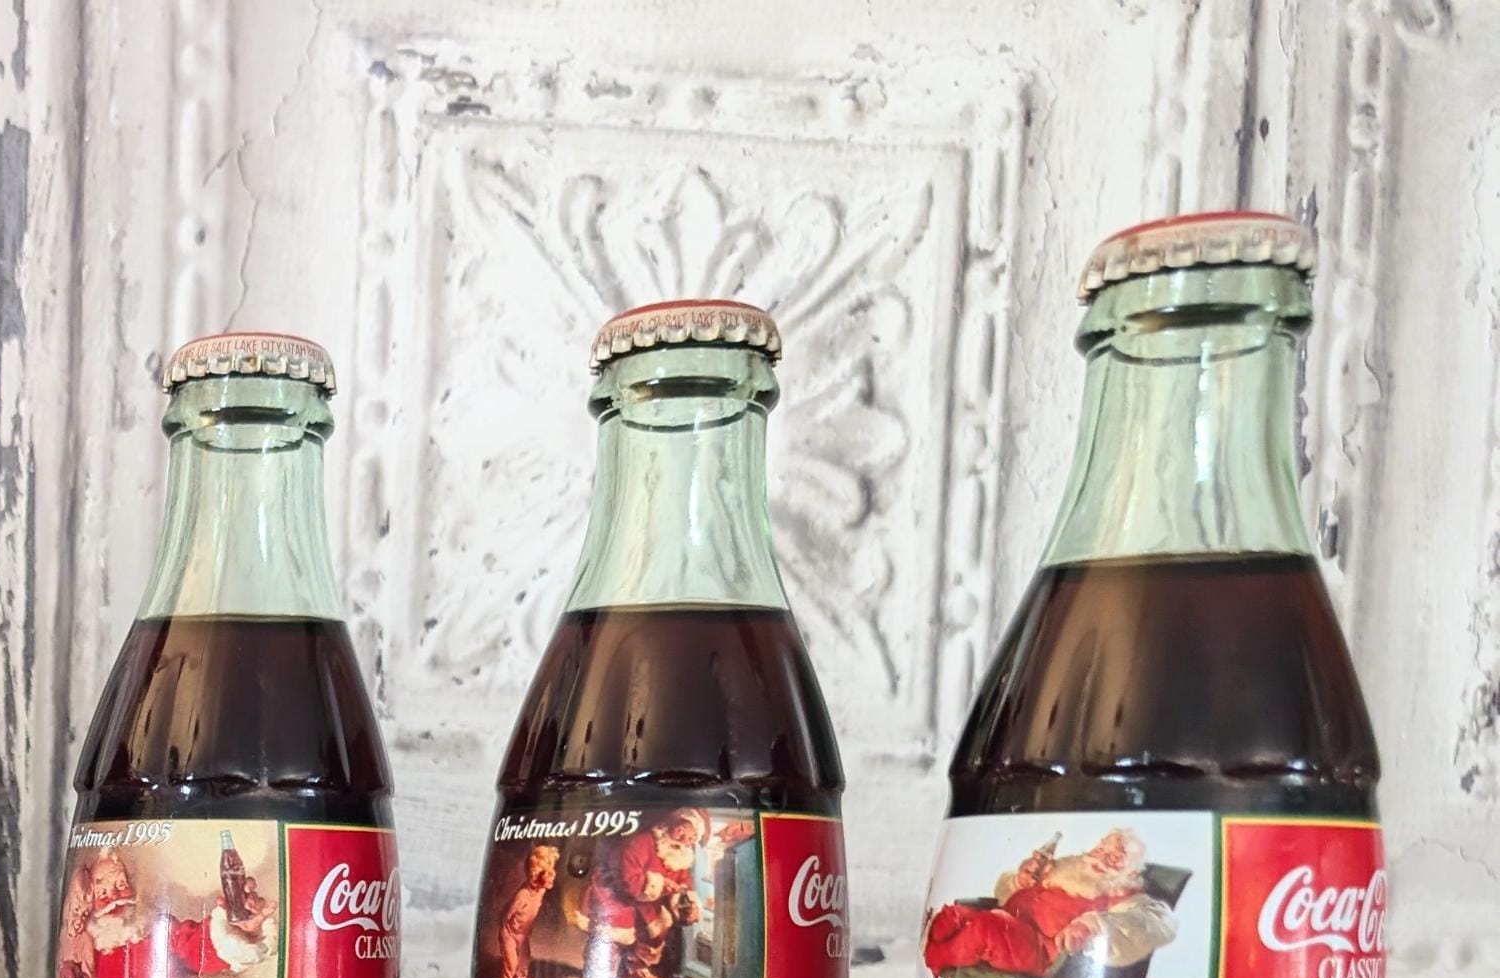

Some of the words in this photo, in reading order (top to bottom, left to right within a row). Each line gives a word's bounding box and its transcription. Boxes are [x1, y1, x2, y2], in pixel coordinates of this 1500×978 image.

[664, 312, 687, 328] SALT
[691, 311, 714, 327] LAKE
[719, 311, 740, 328] CITY
[210, 341, 231, 354] SALT
[234, 339, 258, 352] LAKE
[261, 339, 283, 352] CITY
[284, 342, 307, 355] UTAH
[69, 824, 123, 849] hristmas
[122, 820, 175, 846] 1995
[493, 816, 576, 843] Christmas
[578, 810, 643, 836] 1995
